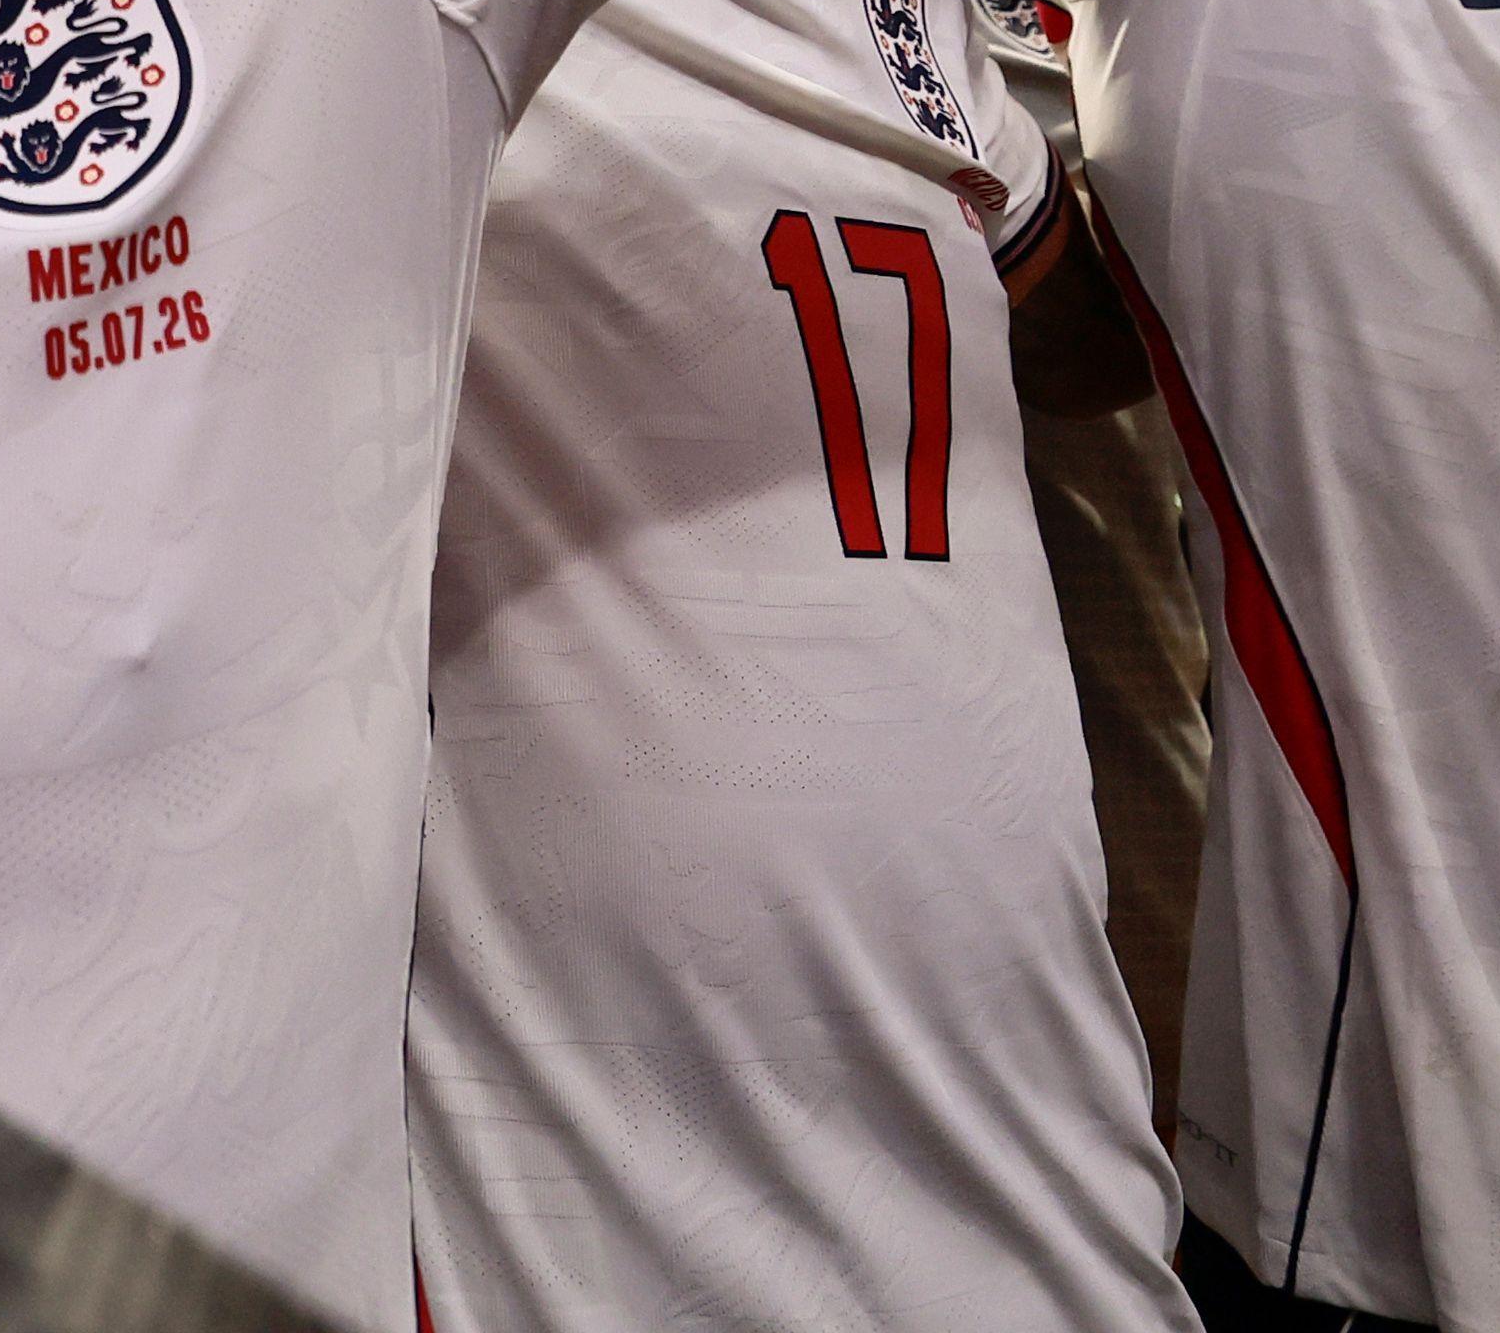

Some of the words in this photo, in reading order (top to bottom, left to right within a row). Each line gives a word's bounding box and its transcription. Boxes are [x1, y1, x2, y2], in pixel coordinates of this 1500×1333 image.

[28, 215, 190, 303] MEXICO
[45, 290, 211, 381] 05.07.26
[761, 209, 952, 562] 17
